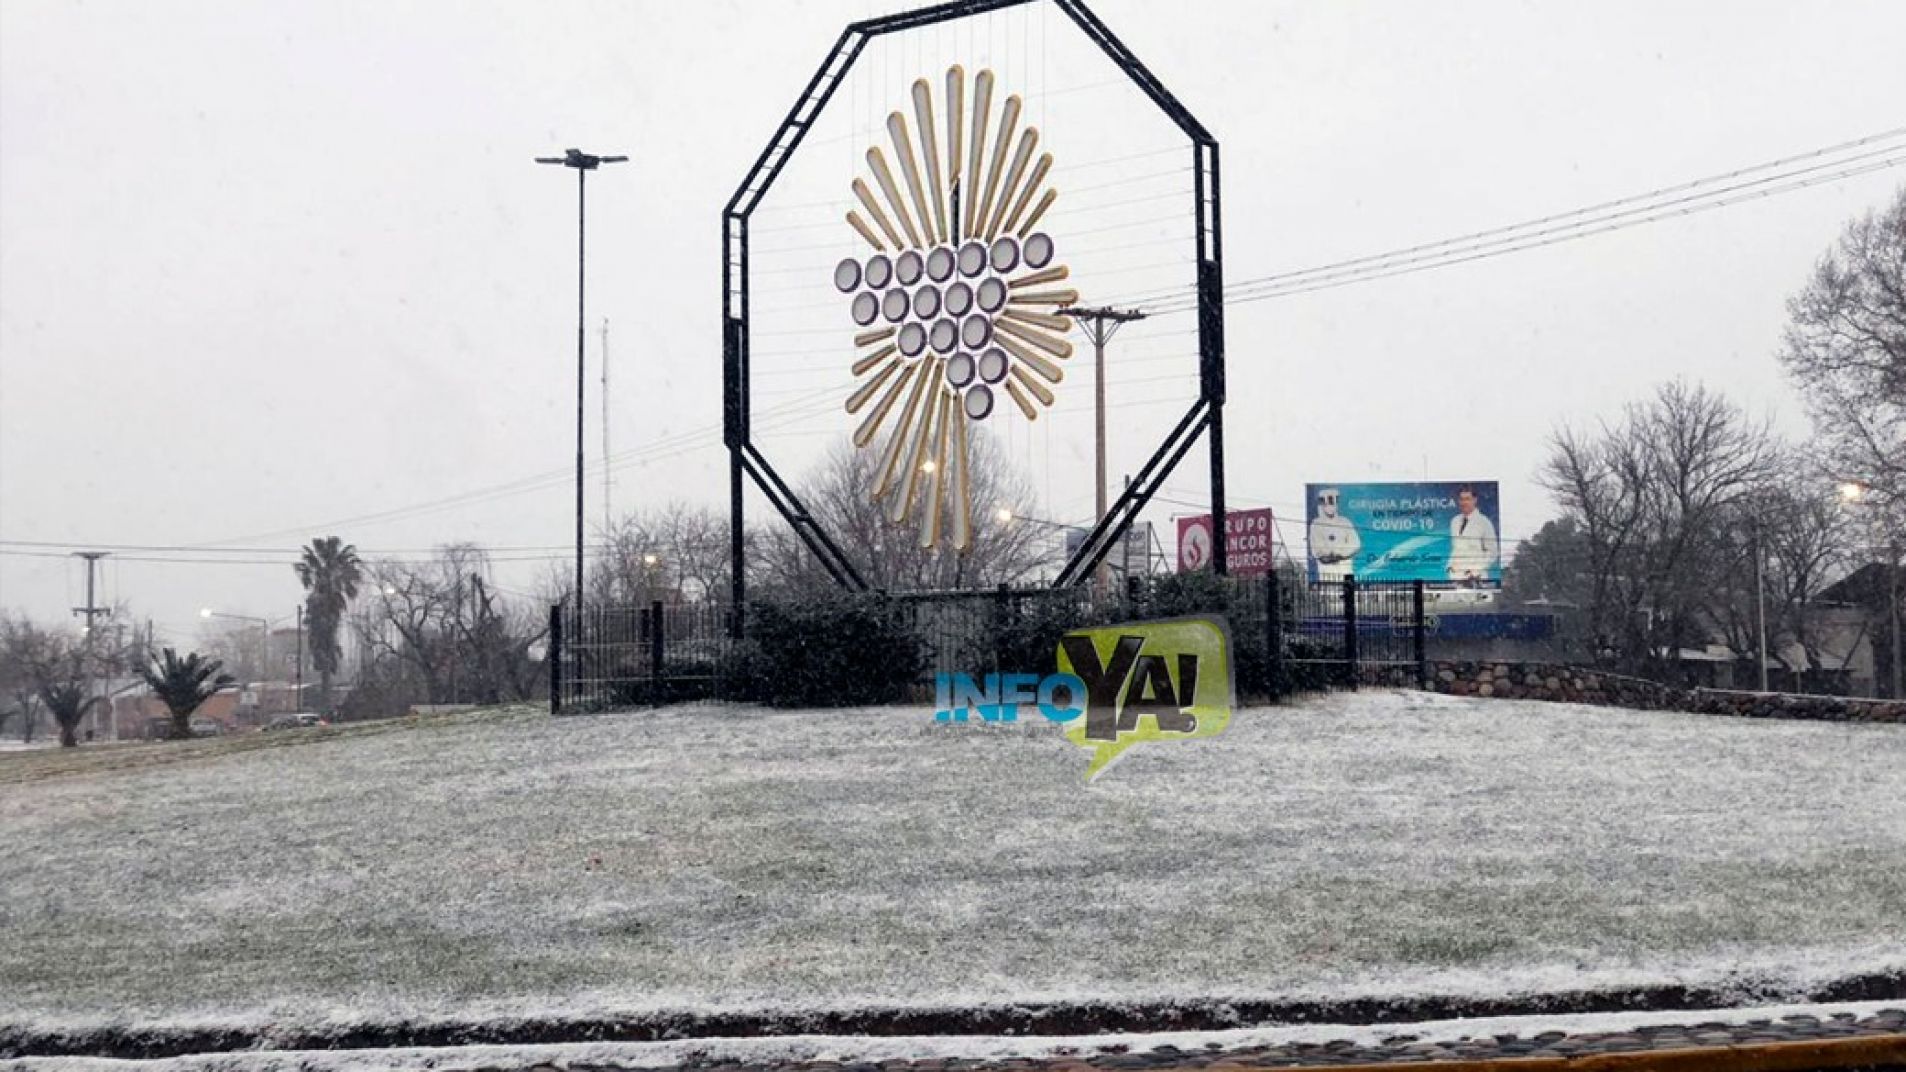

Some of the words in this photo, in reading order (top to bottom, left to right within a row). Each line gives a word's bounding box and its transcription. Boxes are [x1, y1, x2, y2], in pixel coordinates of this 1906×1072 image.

[1400, 496, 1456, 509] PLÁSTICA
[1225, 516, 1267, 533] RUPO
[1372, 518, 1434, 531] COVID-19
[1226, 534, 1267, 553] NCOR
[1226, 552, 1268, 569] GUROS
